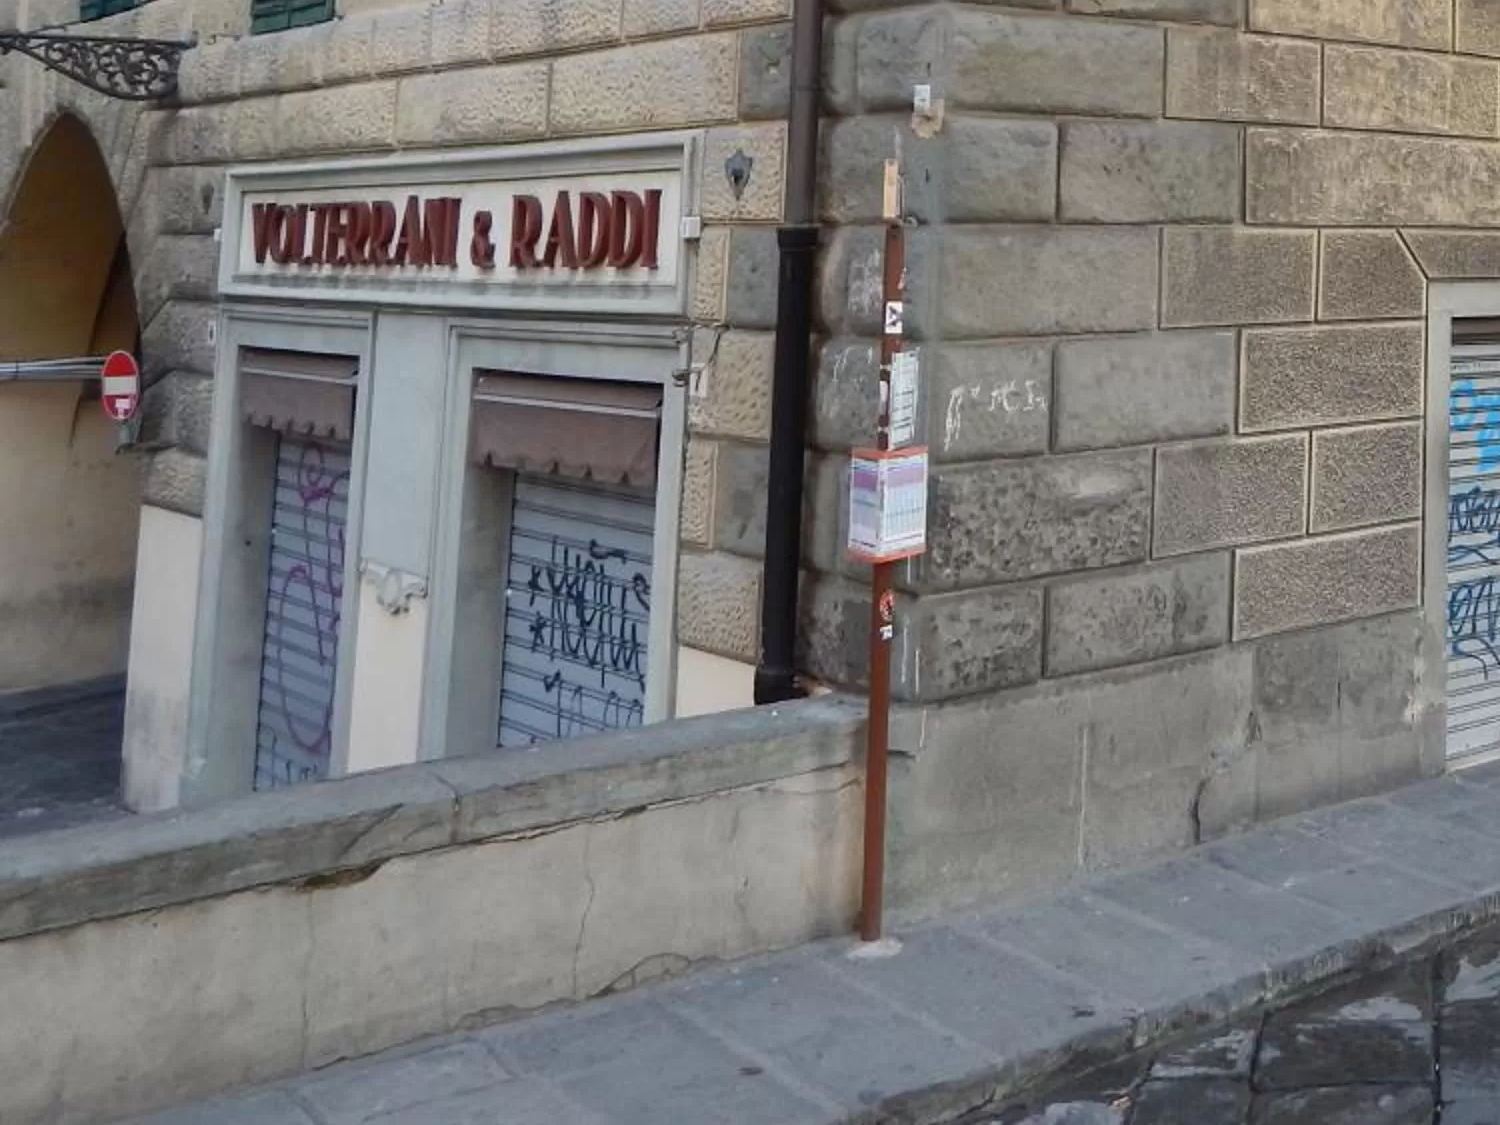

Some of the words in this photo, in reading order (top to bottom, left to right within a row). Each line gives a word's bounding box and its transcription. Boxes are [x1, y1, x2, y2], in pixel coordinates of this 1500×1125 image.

[252, 195, 462, 267] VOLTERRANI
[470, 211, 496, 267] &
[509, 189, 663, 269] RADDI
